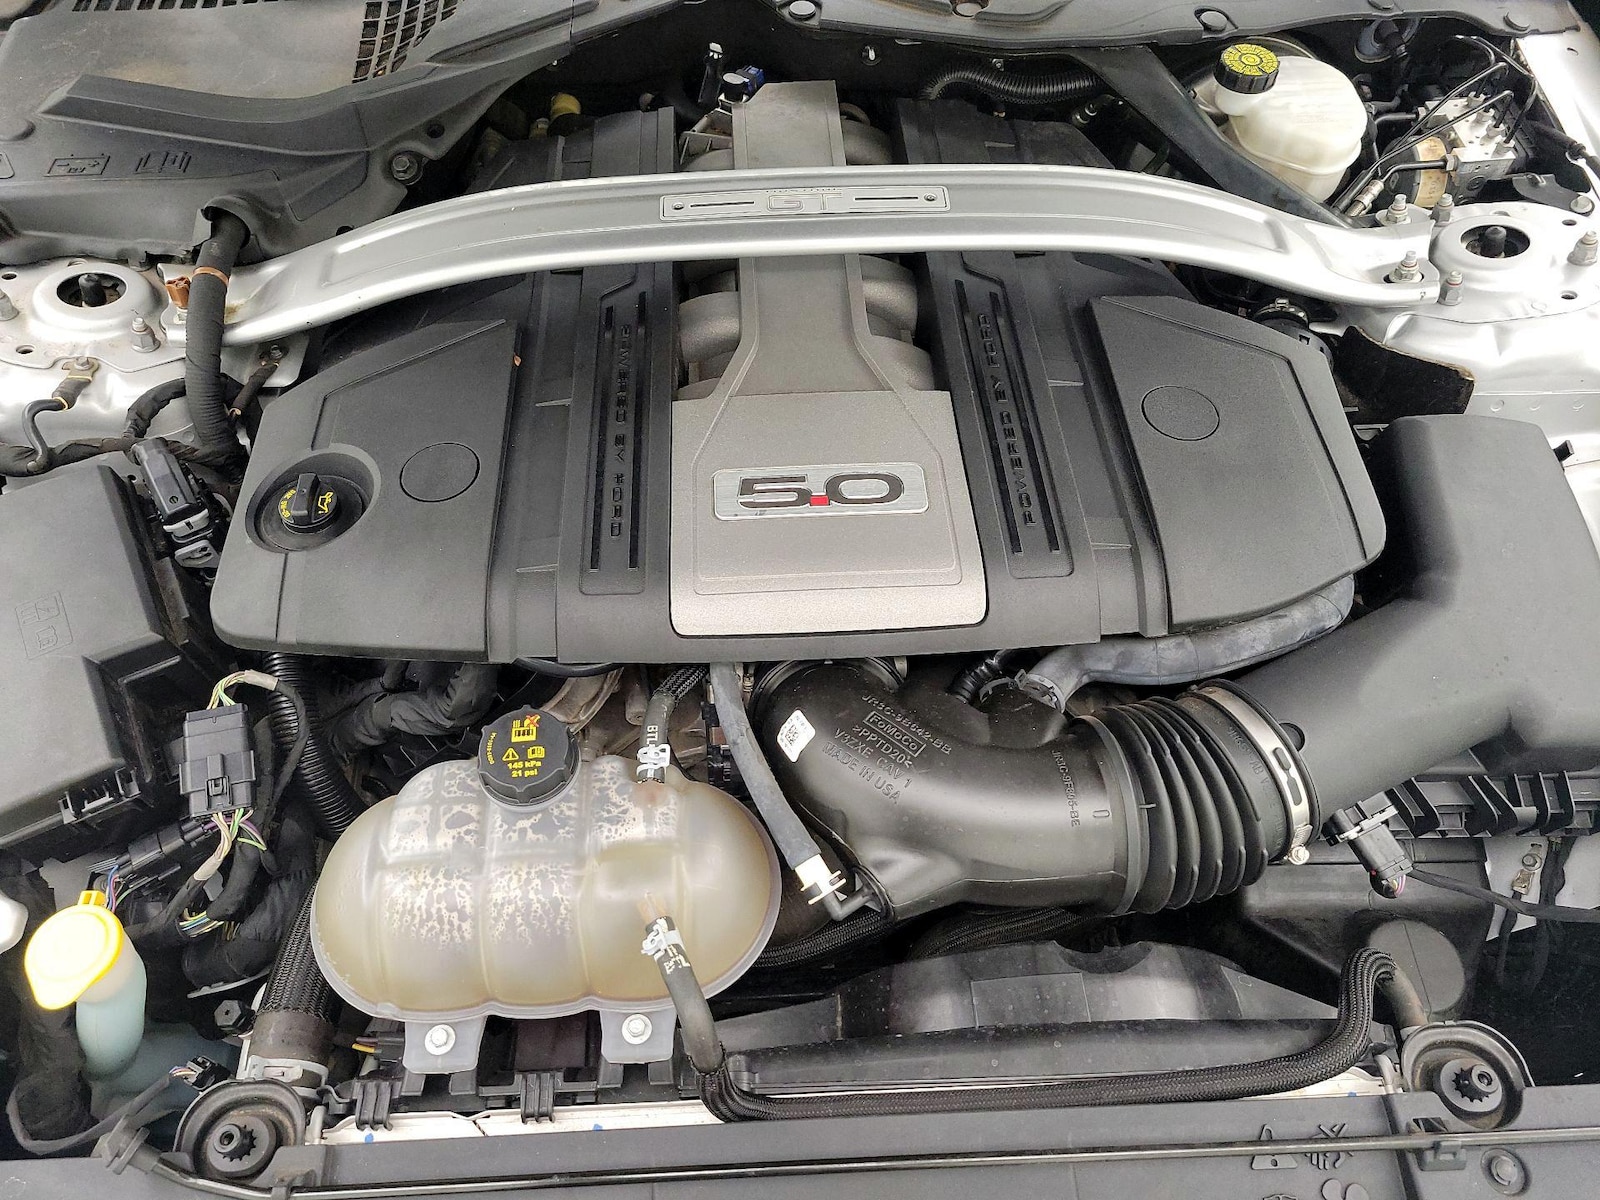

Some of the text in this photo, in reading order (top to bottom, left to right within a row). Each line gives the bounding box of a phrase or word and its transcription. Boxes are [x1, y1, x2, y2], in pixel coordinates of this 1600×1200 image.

[767, 192, 842, 212] GT
[979, 313, 1000, 368] FORD
[1000, 411, 1037, 527] POWERED
[738, 472, 905, 509] 5.0
[870, 714, 918, 751] FoMoCo
[507, 760, 542, 769] 145 kPa
[511, 769, 538, 778] 21 psi
[822, 740, 901, 801] MADE IN USA
